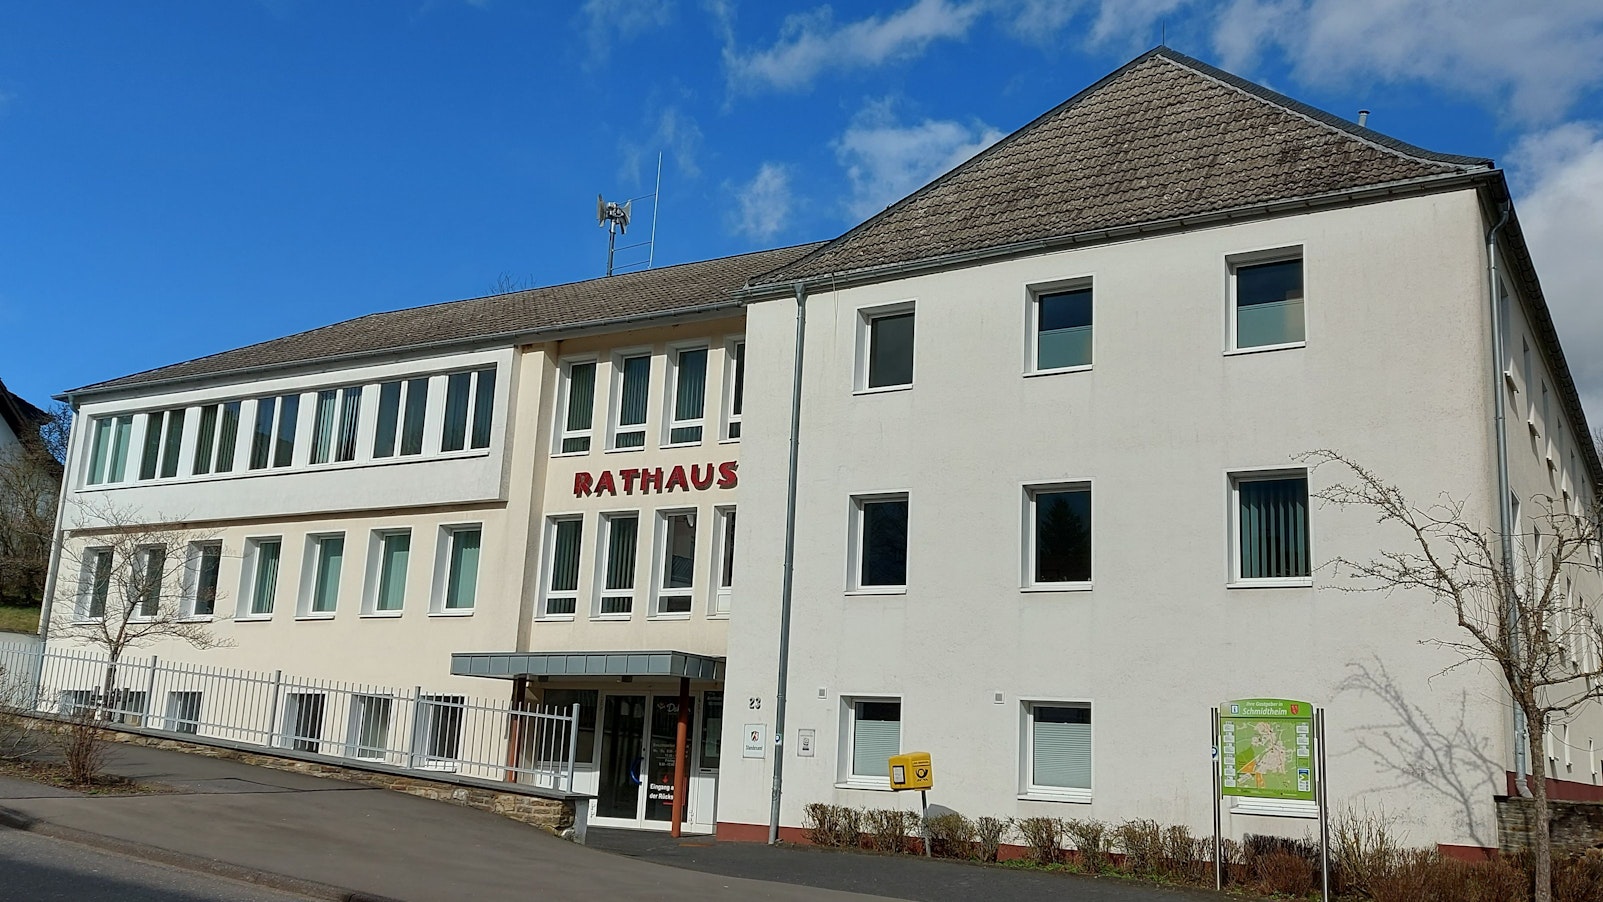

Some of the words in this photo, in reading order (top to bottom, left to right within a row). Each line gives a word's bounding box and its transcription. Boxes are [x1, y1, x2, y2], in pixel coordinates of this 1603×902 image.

[573, 461, 738, 498] RATHAUS
[749, 697, 761, 710] 23
[1243, 707, 1288, 716] Schmidtheim
[650, 783, 670, 791] Eingang
